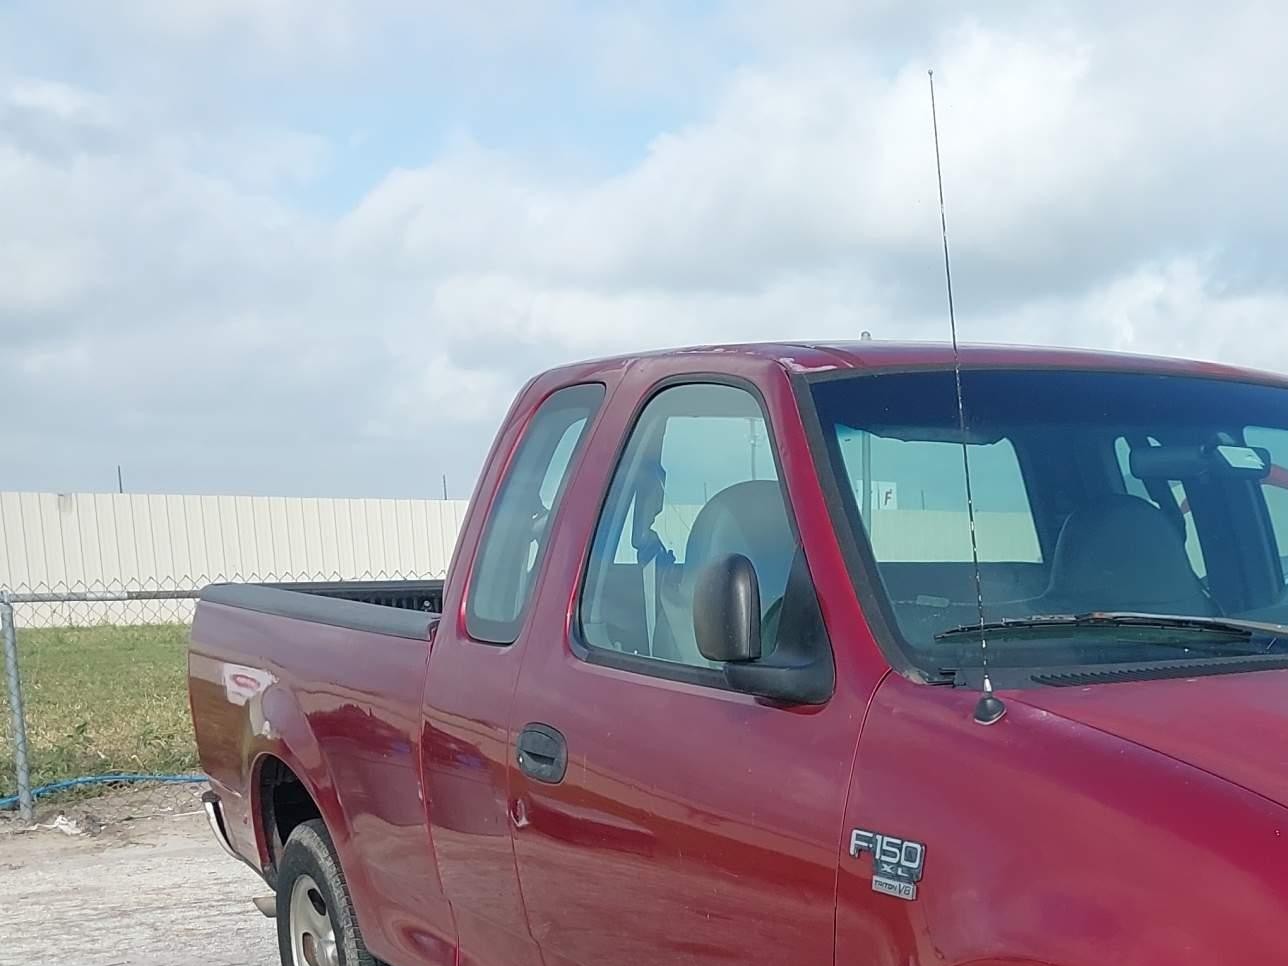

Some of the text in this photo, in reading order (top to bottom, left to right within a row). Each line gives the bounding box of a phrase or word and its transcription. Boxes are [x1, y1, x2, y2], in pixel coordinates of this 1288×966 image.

[881, 863, 909, 877] XL
[873, 879, 912, 897] TRITON V8
